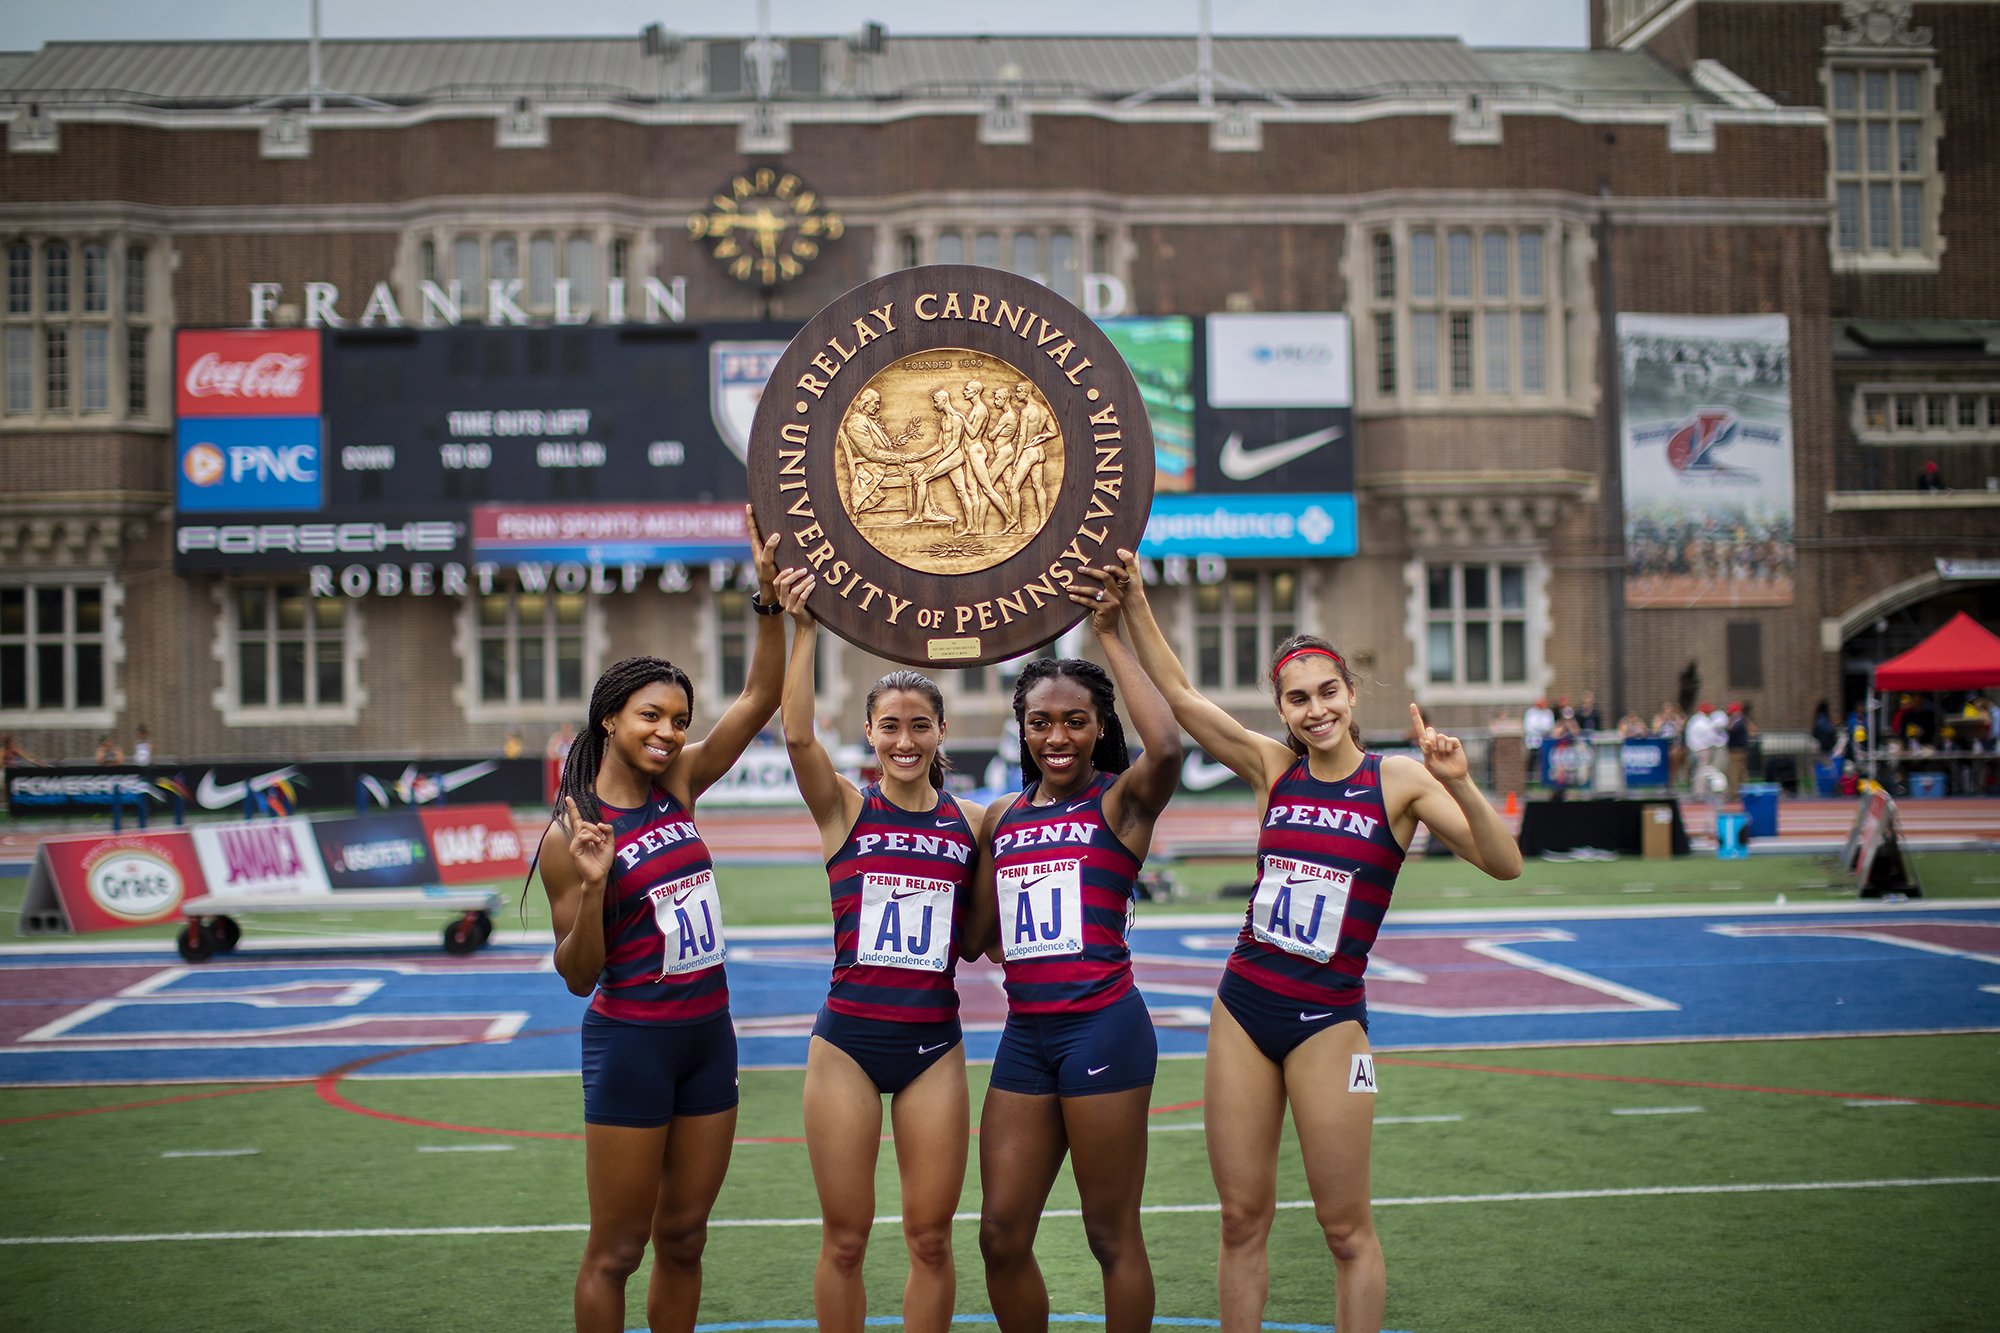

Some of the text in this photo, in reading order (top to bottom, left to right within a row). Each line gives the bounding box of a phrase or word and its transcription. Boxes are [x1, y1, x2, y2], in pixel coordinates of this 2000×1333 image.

[249, 276, 687, 328] FRANKLIN
[796, 303, 898, 399] RELAY
[915, 293, 1094, 387] CARNIVAL
[905, 359, 983, 371] FOUNDED 1895
[227, 445, 317, 483] PNC
[779, 423, 913, 626] UNIVERSITY
[954, 403, 1123, 633] PENNSYLVANIA
[1148, 507, 1295, 546] pendence
[176, 522, 457, 554] PORSCHE
[309, 562, 499, 598] ROBERT
[517, 560, 646, 595] WOLF
[658, 559, 692, 594] &
[1266, 804, 1378, 839] PENN
[617, 821, 701, 869] PENN
[856, 832, 971, 865] PENN
[994, 822, 1098, 858] PENN
[654, 871, 711, 900] PENN RELAYS
[868, 875, 951, 893] PENN RELAYS
[1001, 861, 1076, 879] PENN RELAYS
[1269, 858, 1347, 884] PENN RELAYS
[674, 900, 716, 960] AJ
[874, 901, 933, 956] AJ
[1014, 887, 1062, 944] AJ
[1267, 885, 1326, 945] AJ
[668, 952, 720, 973] Independence
[862, 952, 931, 966] Independence
[1007, 942, 1065, 957] Independence
